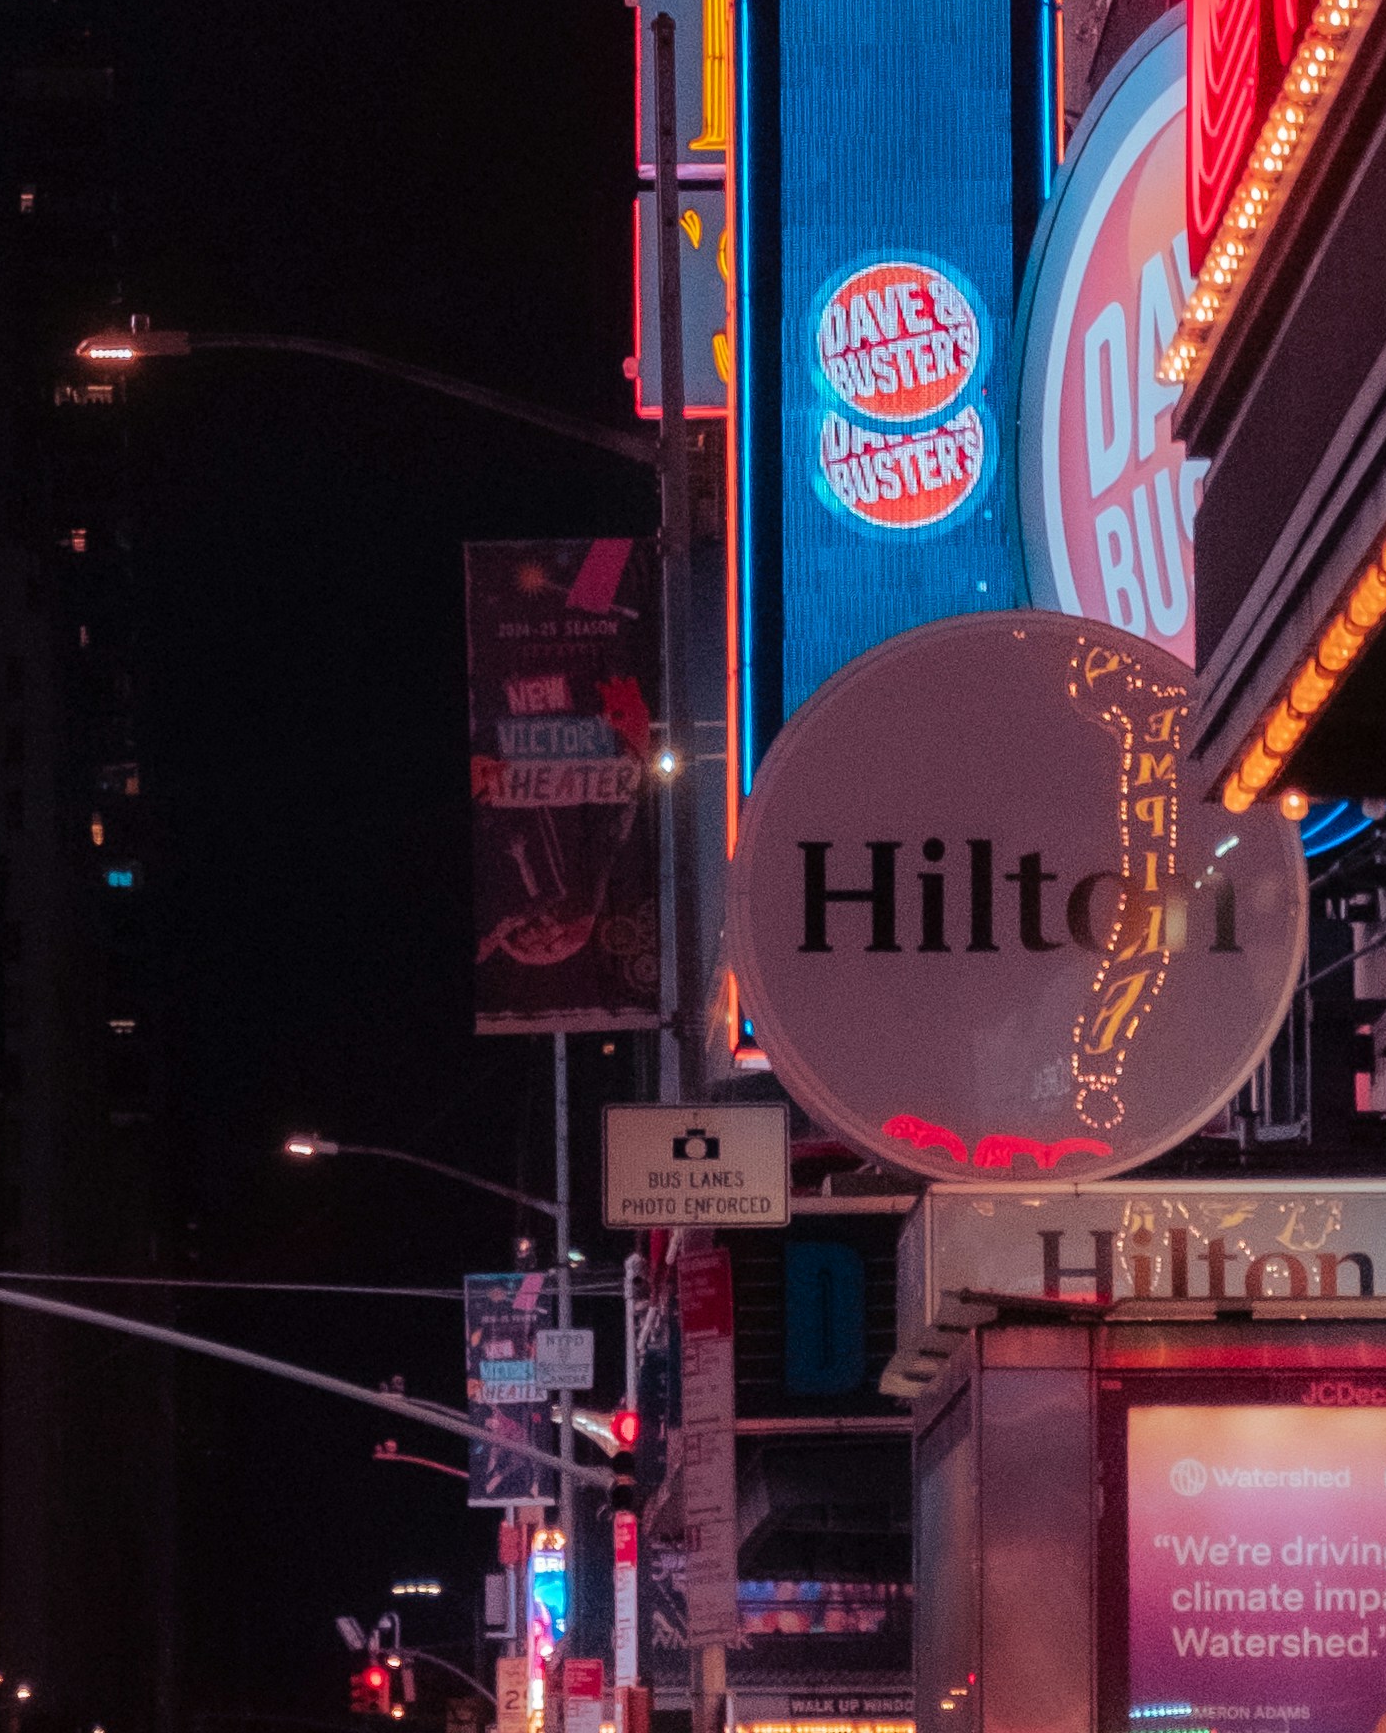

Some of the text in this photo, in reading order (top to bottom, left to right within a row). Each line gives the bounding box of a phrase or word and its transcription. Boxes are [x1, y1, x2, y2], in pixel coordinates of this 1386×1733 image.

[822, 280, 969, 357] DAVE &
[648, 1170, 744, 1189] BUS LANES
[622, 1196, 771, 1216] PHOTO ENFORCED
[1036, 1228, 1374, 1301] Hilton
[1212, 1465, 1352, 1489] Watershed
[1172, 1580, 1305, 1612] climate
[791, 1698, 914, 1714] WALK UP WINDO
[1193, 1705, 1311, 1721] MERON ADAMS
